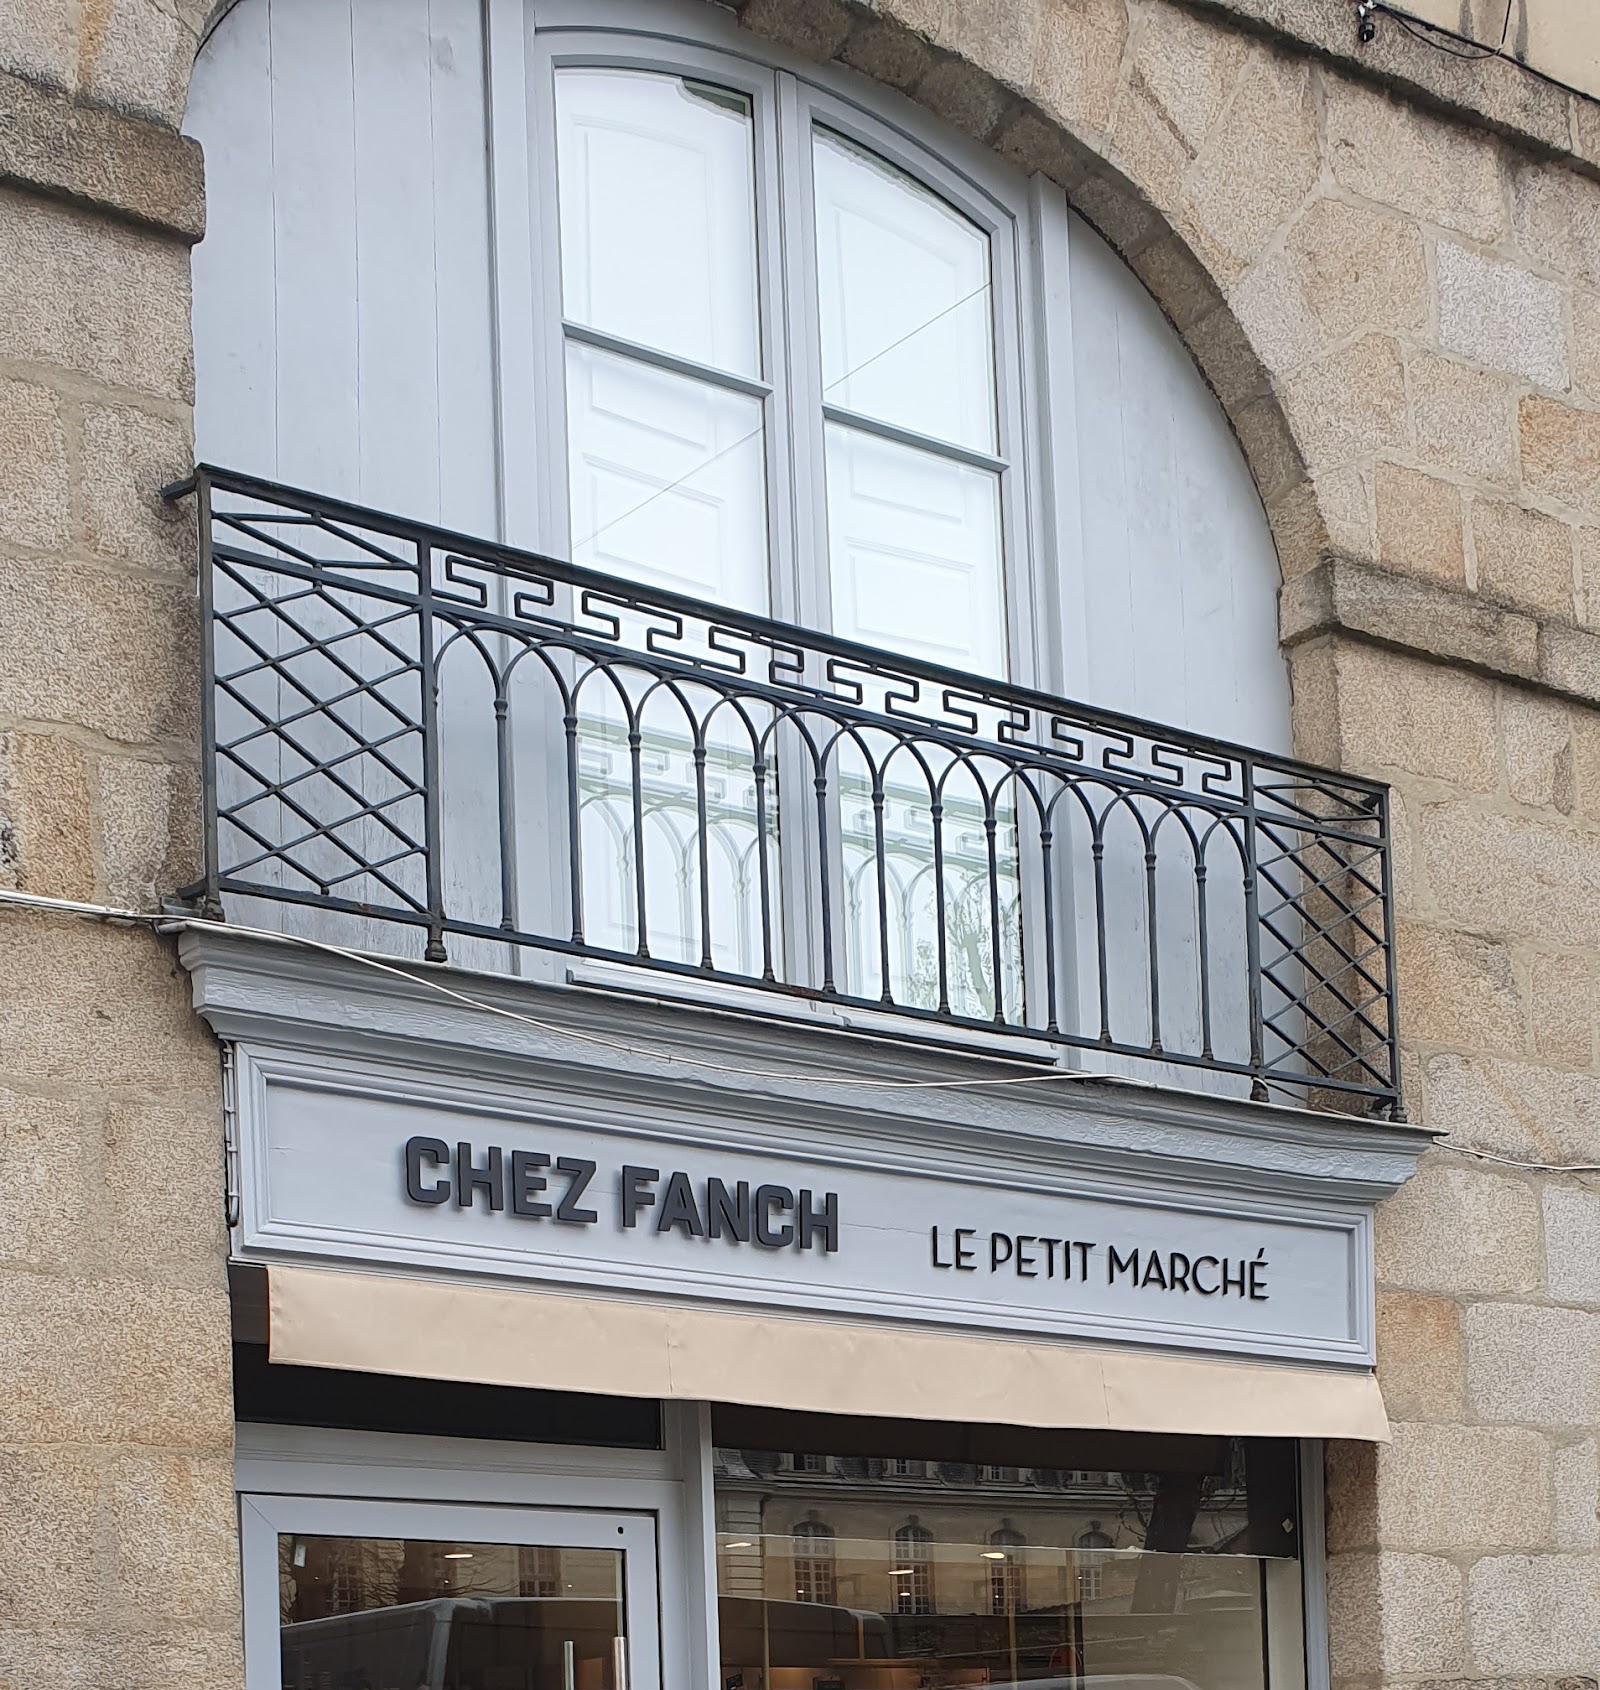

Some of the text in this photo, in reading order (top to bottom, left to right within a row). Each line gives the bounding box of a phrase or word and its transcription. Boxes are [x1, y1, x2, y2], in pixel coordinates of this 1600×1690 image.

[405, 1135, 838, 1252] CHEZ FANCH
[932, 1225, 1270, 1301] LE PETIT MARCHÉ
